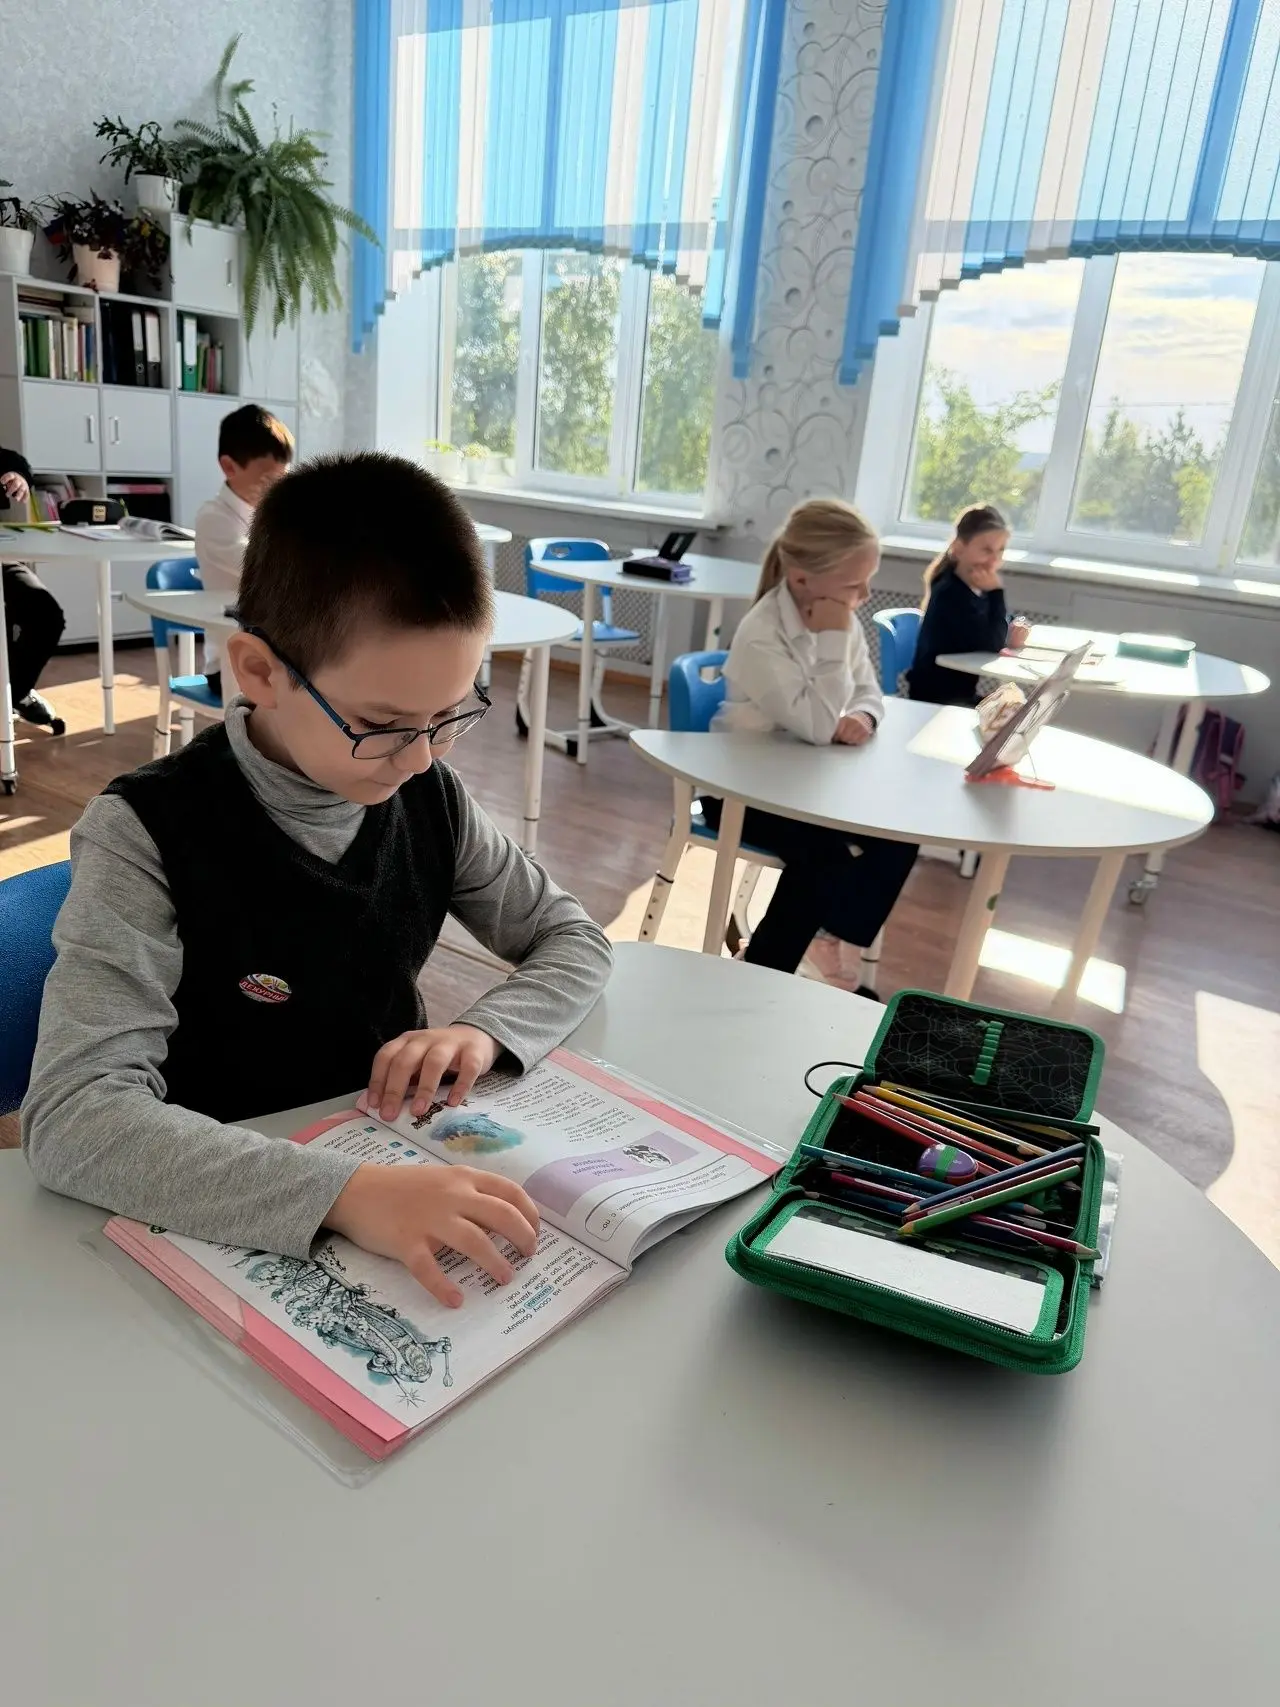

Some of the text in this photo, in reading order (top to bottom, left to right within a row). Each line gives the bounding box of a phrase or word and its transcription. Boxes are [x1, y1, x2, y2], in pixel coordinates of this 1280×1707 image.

[442, 1254, 470, 1275] ольшие
[562, 1253, 576, 1267] сам
[548, 1264, 563, 1277] про
[532, 1275, 550, 1291] себя
[551, 1287, 562, 1297] на
[531, 1296, 552, 1314] сосну
[499, 1311, 533, 1338] большую,
